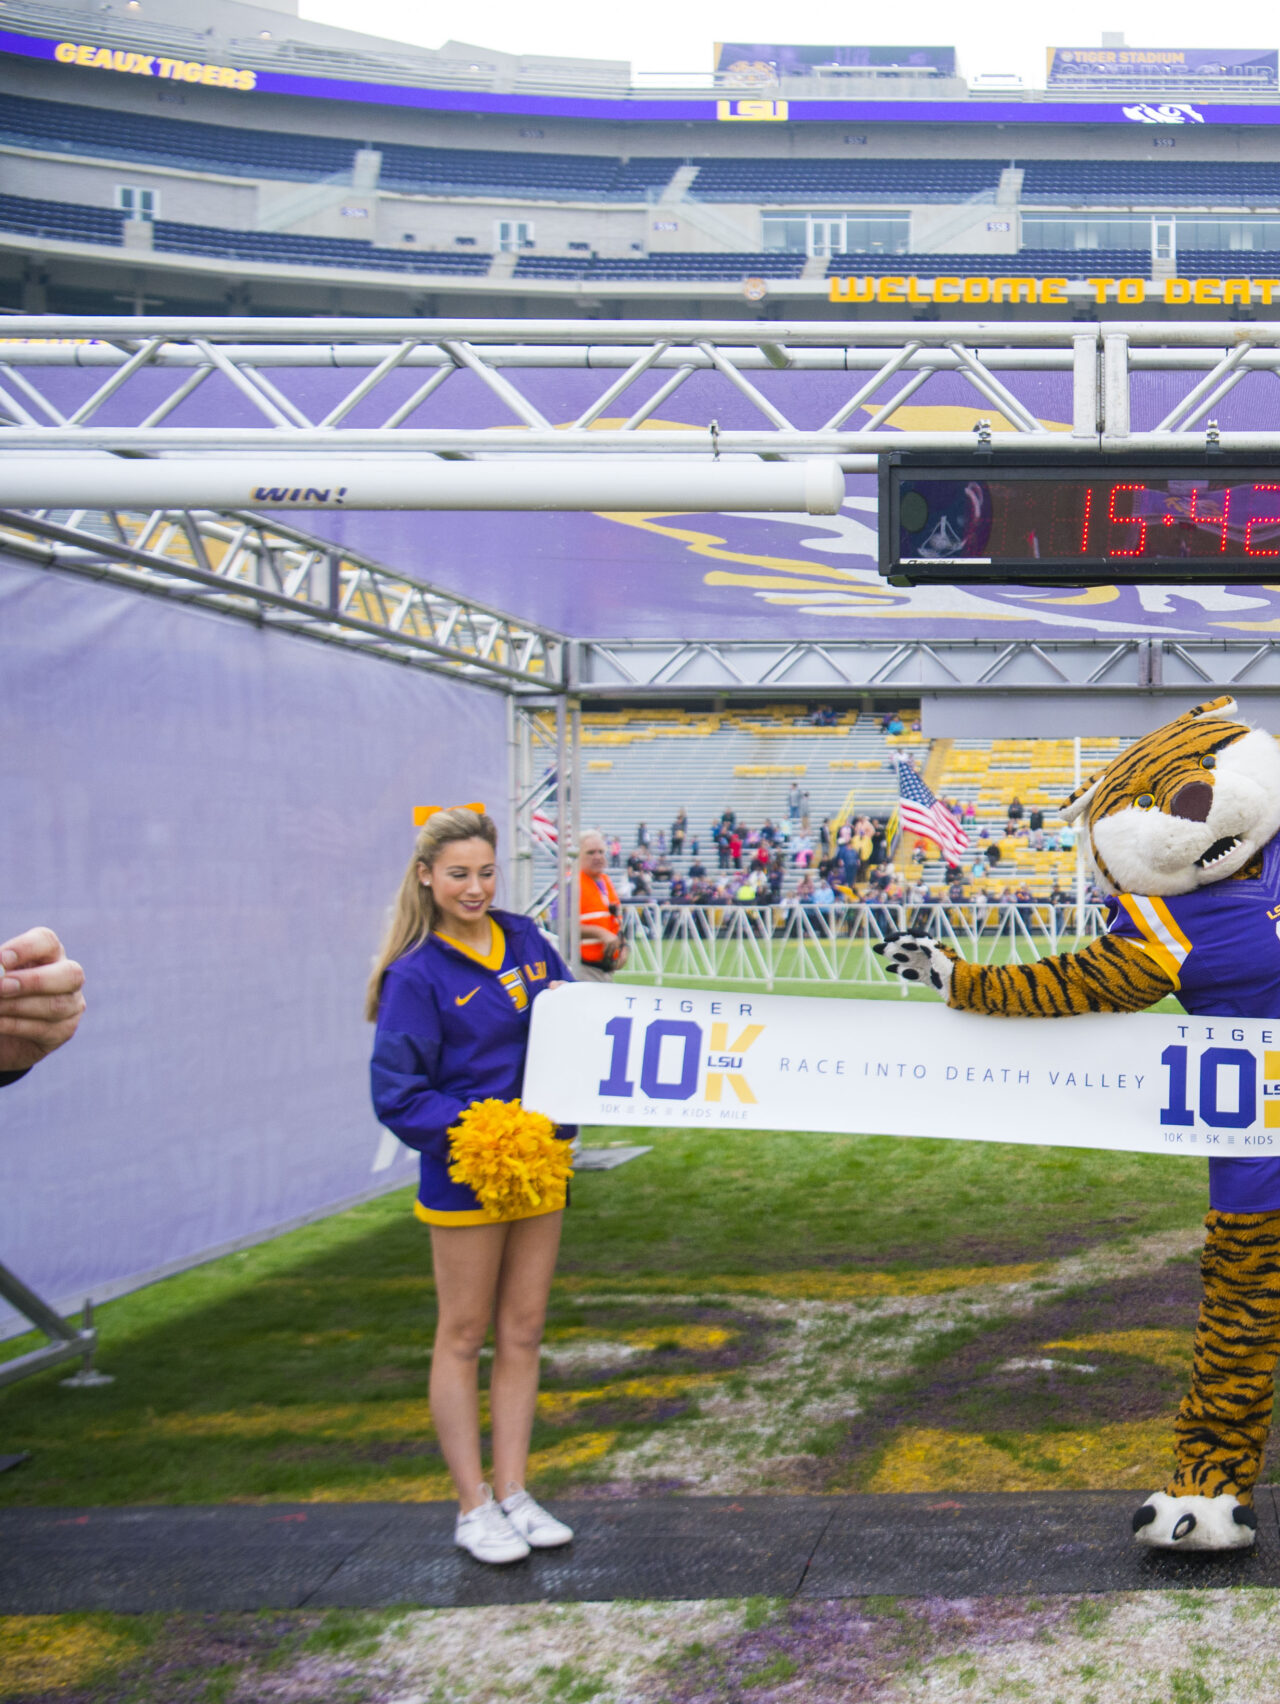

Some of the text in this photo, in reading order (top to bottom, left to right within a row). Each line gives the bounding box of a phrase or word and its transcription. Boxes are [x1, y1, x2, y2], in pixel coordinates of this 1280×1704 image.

[55, 42, 258, 91] GEAUX TIGERS
[1074, 51, 1185, 64] TIGER STADIUM
[716, 100, 788, 121] LSU
[828, 276, 1069, 303] WELCOME
[1087, 278, 1145, 304] TO
[250, 486, 348, 504] WIN!
[625, 997, 753, 1017] TIGER
[598, 1015, 767, 1104] 10K
[707, 1055, 743, 1068] LSU
[780, 1057, 1145, 1089] RACE INTO DEATH VALLEY
[601, 1103, 749, 1120] 10K 5K KIDS MILE
[1164, 1132, 1183, 1142] 10K
[1206, 1134, 1220, 1144] 5K
[1244, 1135, 1273, 1145] KIDS
